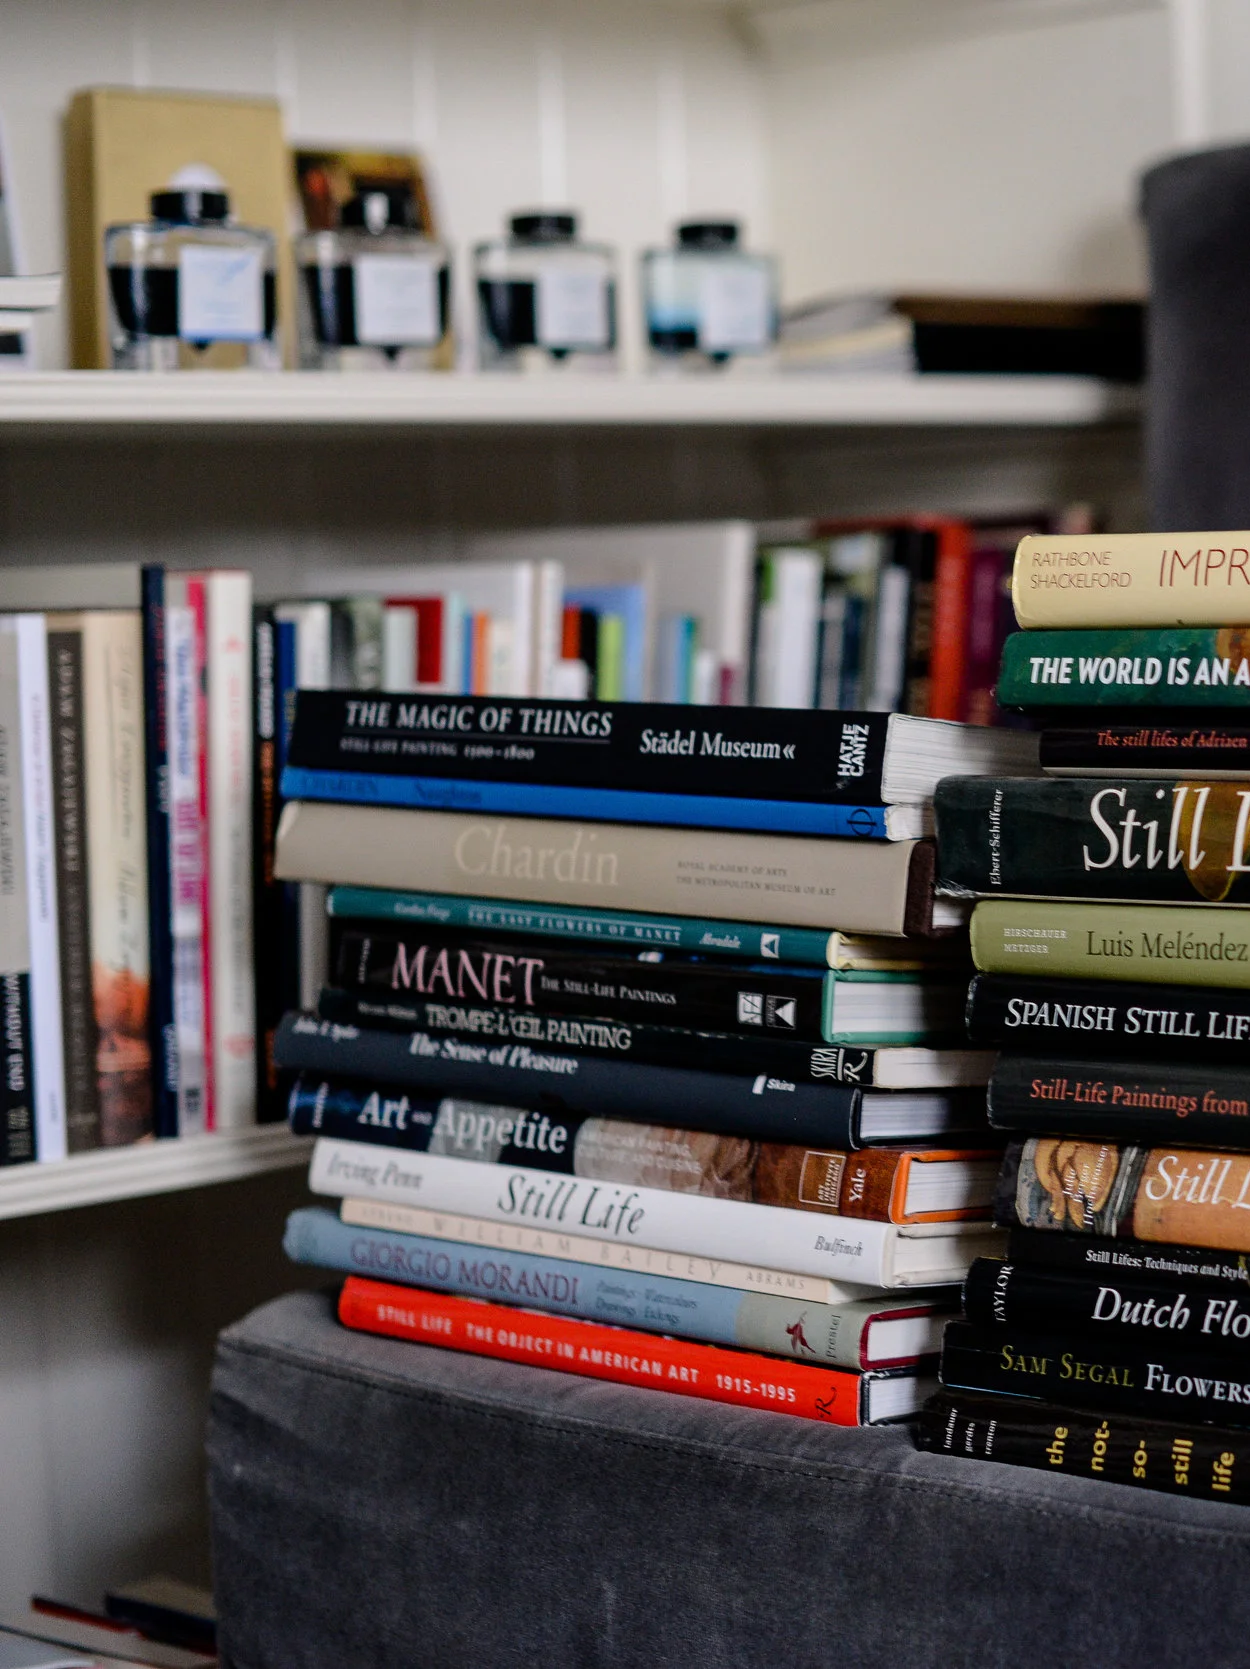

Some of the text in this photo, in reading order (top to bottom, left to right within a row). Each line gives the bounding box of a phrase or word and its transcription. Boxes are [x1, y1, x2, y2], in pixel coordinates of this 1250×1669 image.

[1031, 551, 1112, 567] RATHBONE
[1030, 571, 1132, 590] SHACKELFORD
[1029, 657, 1073, 684] THE
[1077, 657, 1162, 684] WORLD
[1167, 657, 1190, 685] IS
[1194, 657, 1231, 685] AN
[346, 701, 613, 737] THE MAGIC OF THINGS
[1097, 730, 1120, 746] The
[1121, 730, 1149, 747] still
[1151, 730, 1178, 747] lifes
[1181, 730, 1199, 747] of
[1198, 731, 1248, 748] Adriaen
[639, 729, 696, 756] Städel
[837, 722, 856, 777] HATJE
[848, 723, 871, 778] CANTZ
[989, 789, 1004, 886] Ebert-Schifferer
[1083, 786, 1211, 871] Still
[454, 823, 619, 887] Chardin
[1003, 927, 1067, 939] HIRSCHAUER
[1003, 943, 1050, 954] METZGER
[1086, 930, 1249, 962] Luis Meléndez
[391, 941, 545, 1006] MANET
[619, 984, 677, 1005] PAINTINGS
[547, 1018, 633, 1050] PAINTING
[1004, 998, 1117, 1031] SPANISH
[1124, 1007, 1201, 1038] STILL
[410, 1031, 440, 1057] The
[488, 1043, 507, 1065] of
[508, 1045, 580, 1075] Pleasure
[810, 1048, 839, 1080] SKIRA
[766, 1078, 797, 1093] Skira
[1030, 1078, 1107, 1104] Still-Life
[1111, 1083, 1198, 1118] Paintings
[1202, 1090, 1248, 1117] from
[357, 1091, 411, 1130] Art
[432, 1098, 568, 1154] Appetite
[848, 1168, 867, 1203] Yale
[1146, 1154, 1232, 1205] Still
[498, 1172, 647, 1236] Still Life
[433, 1217, 721, 1281] WILLIAM BAILEY
[1085, 1249, 1111, 1264] Still
[1112, 1252, 1142, 1268] Lifes:
[1144, 1257, 1199, 1276] Techniques
[1200, 1264, 1220, 1277] and
[350, 1236, 450, 1282] GIORGIO
[458, 1258, 581, 1306] MORANDI
[745, 1271, 807, 1291] ABRAMS
[1091, 1286, 1190, 1331] Dutch
[377, 1303, 797, 1403] STILL LIFE THE OBJECT IN AMERICAN ART 1915-1995
[826, 1313, 842, 1359] Prestel
[1000, 1345, 1050, 1376] SAM
[1059, 1352, 1135, 1388] SEGAL
[1046, 1426, 1069, 1465] the
[1091, 1420, 1110, 1472] not-
[1132, 1440, 1148, 1480] so-
[1172, 1438, 1194, 1486] still
[1212, 1451, 1236, 1492] life
